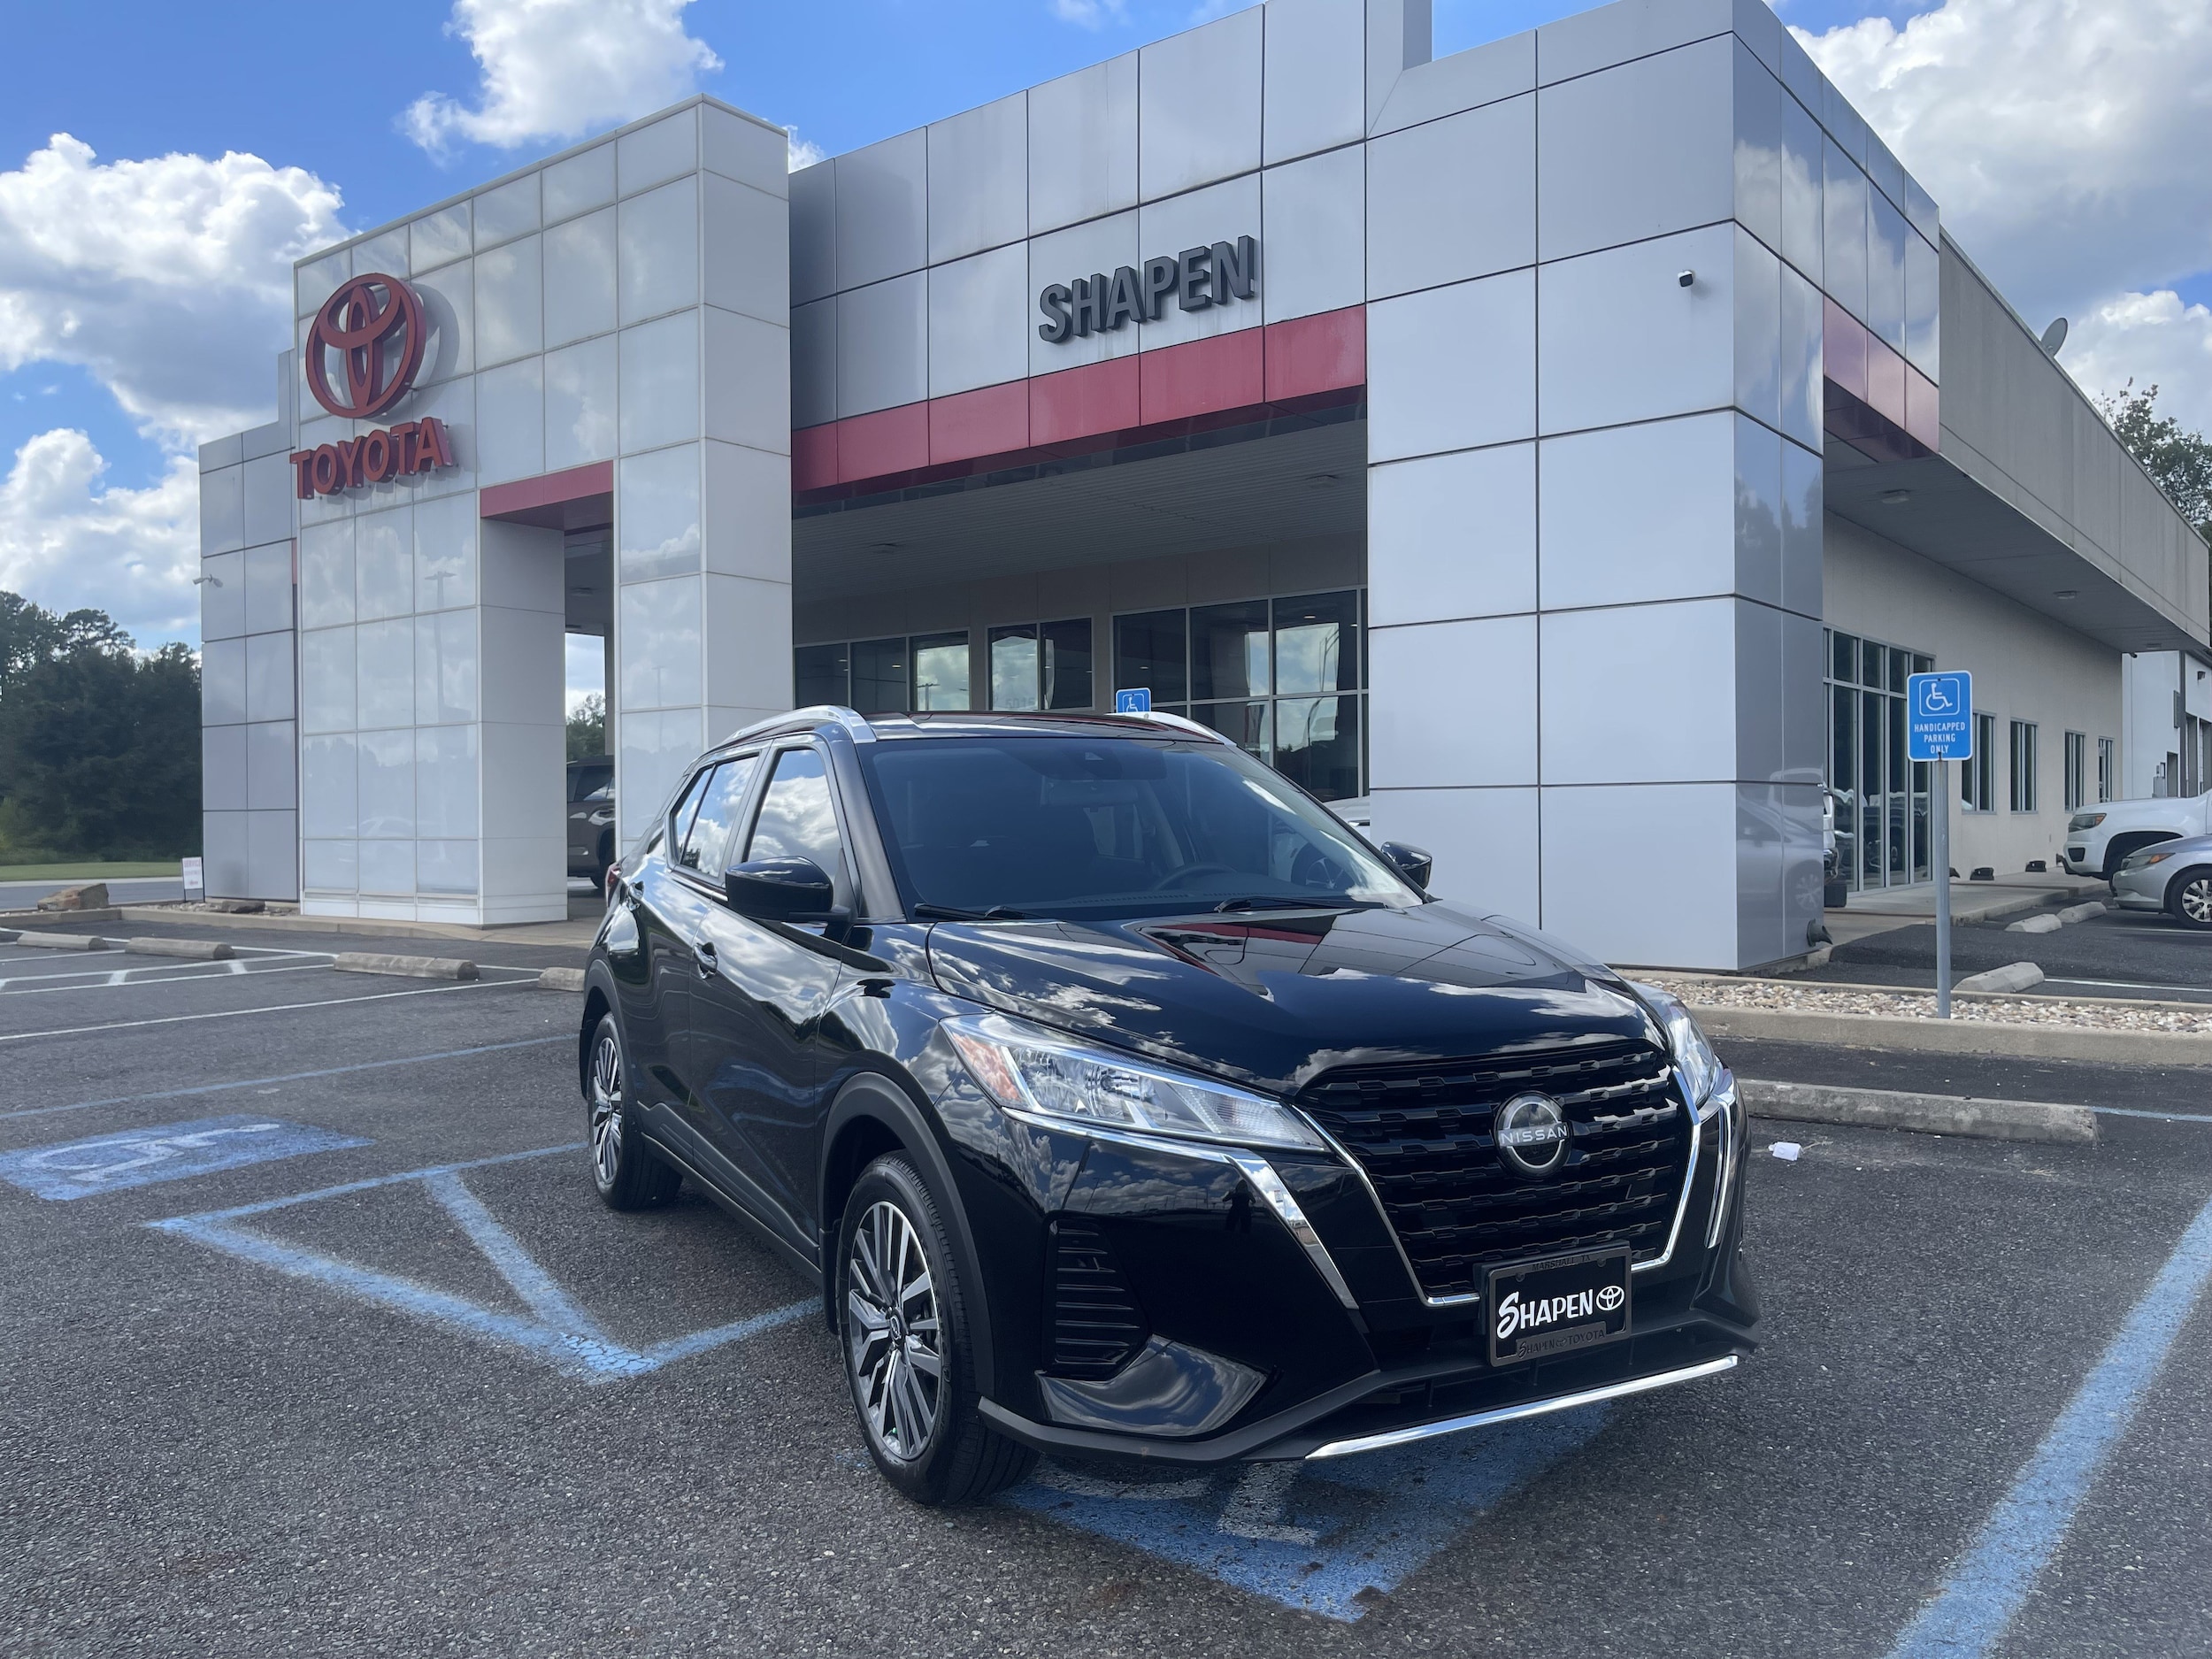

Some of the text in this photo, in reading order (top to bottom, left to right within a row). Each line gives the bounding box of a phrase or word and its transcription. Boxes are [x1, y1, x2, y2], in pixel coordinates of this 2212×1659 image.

[1039, 234, 1255, 343] SHAPEN
[289, 417, 453, 499] TOYOTA
[1914, 722, 1966, 733] HANDICAPPED
[1924, 733, 1956, 743] PARKING
[1930, 744, 1949, 754] ONLY
[1500, 1125, 1568, 1144] NISSAN
[1532, 1256, 1577, 1271] MARSHALL
[1496, 1288, 1594, 1340] SHAPEN
[1517, 1329, 1605, 1359] SHAPEN TOYOTA
